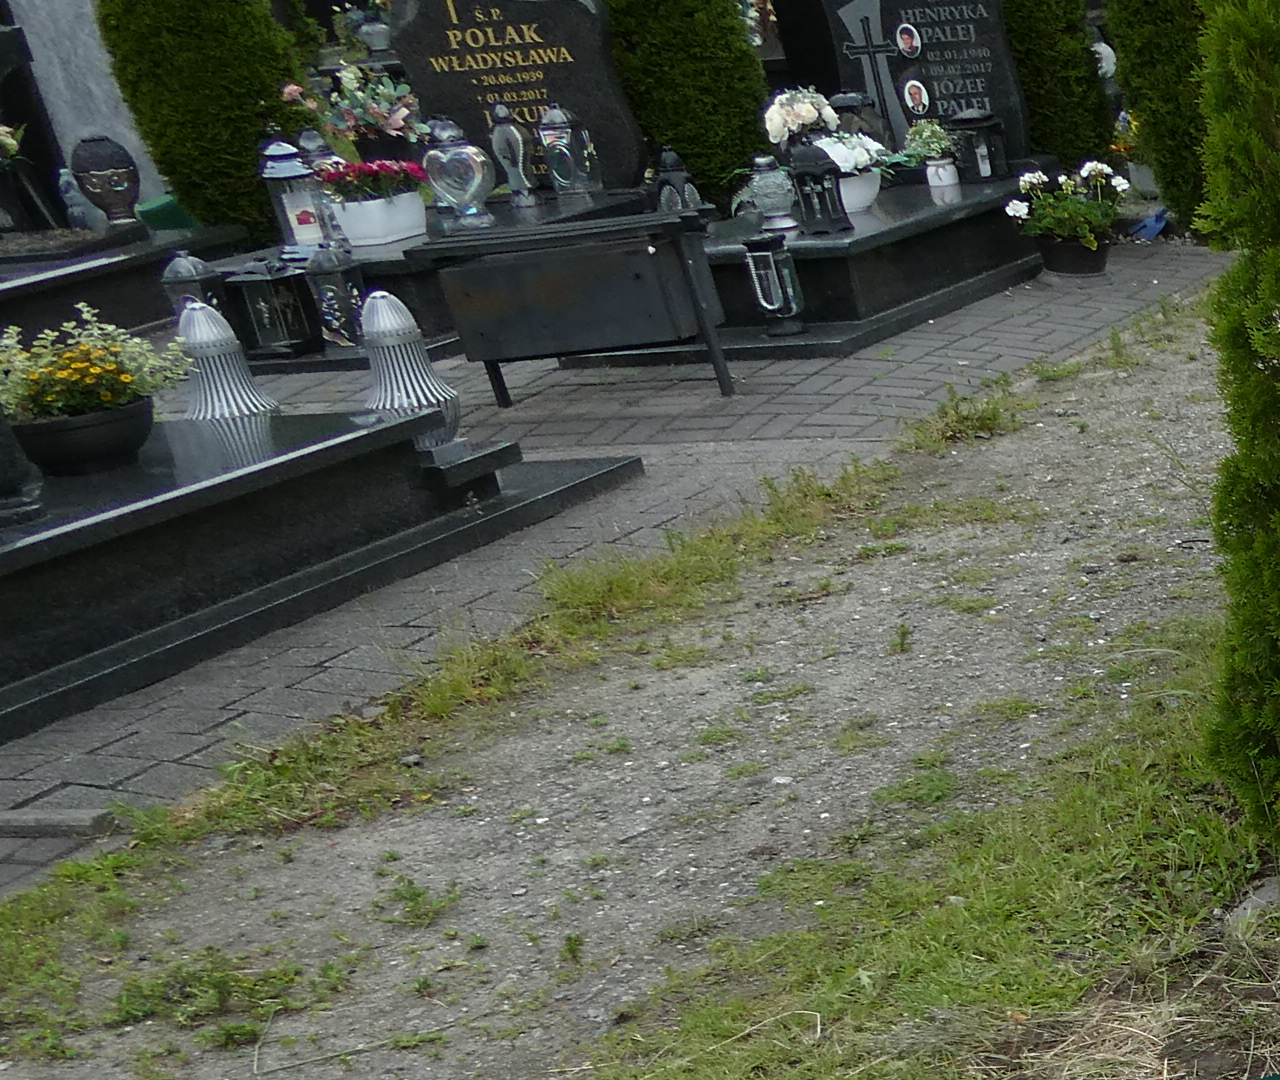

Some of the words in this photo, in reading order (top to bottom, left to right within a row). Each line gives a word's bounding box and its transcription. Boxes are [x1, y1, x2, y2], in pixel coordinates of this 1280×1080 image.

[901, 4, 989, 23] HENRYKA
[445, 23, 545, 49] POLAK
[920, 24, 976, 43] PALEJ
[429, 46, 575, 73] WŁADYSŁAWA
[481, 70, 545, 86] 20.06.1939
[932, 77, 987, 98] JÓZEF
